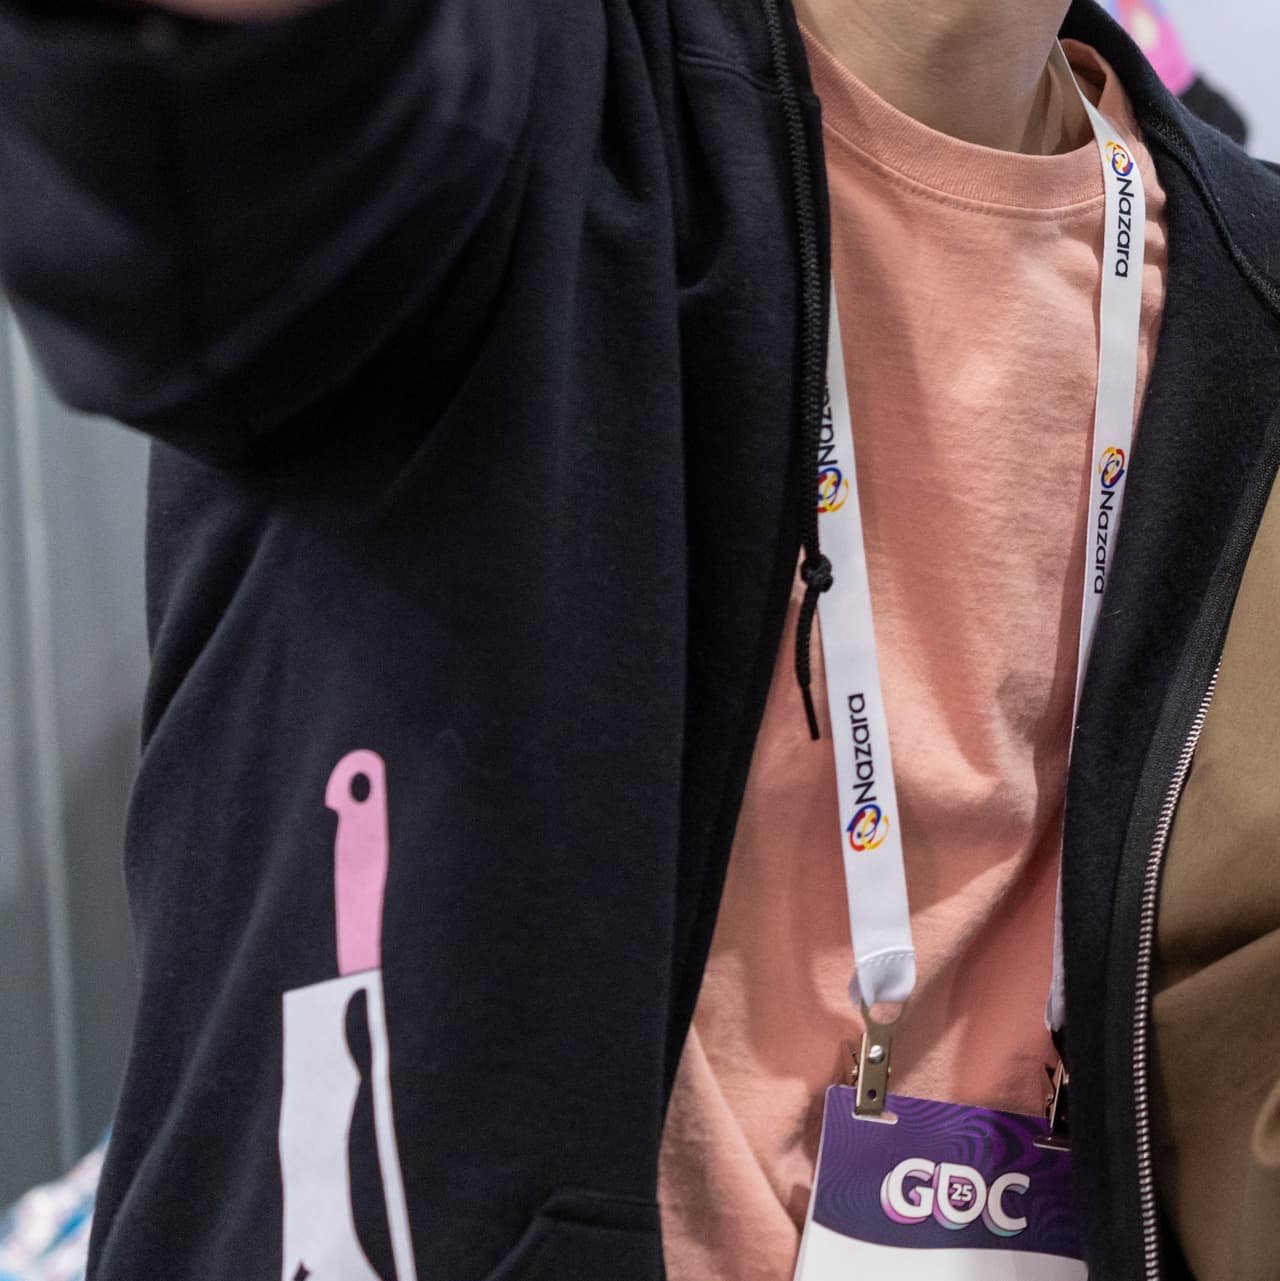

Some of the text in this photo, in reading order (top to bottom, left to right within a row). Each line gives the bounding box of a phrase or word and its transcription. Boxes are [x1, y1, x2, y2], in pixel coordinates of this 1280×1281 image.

[1114, 177, 1134, 278] Nazara
[1093, 491, 1114, 595] Nazara
[847, 692, 878, 806] Nazara
[881, 1157, 1031, 1234] GDC
[951, 1183, 973, 1202] 25
